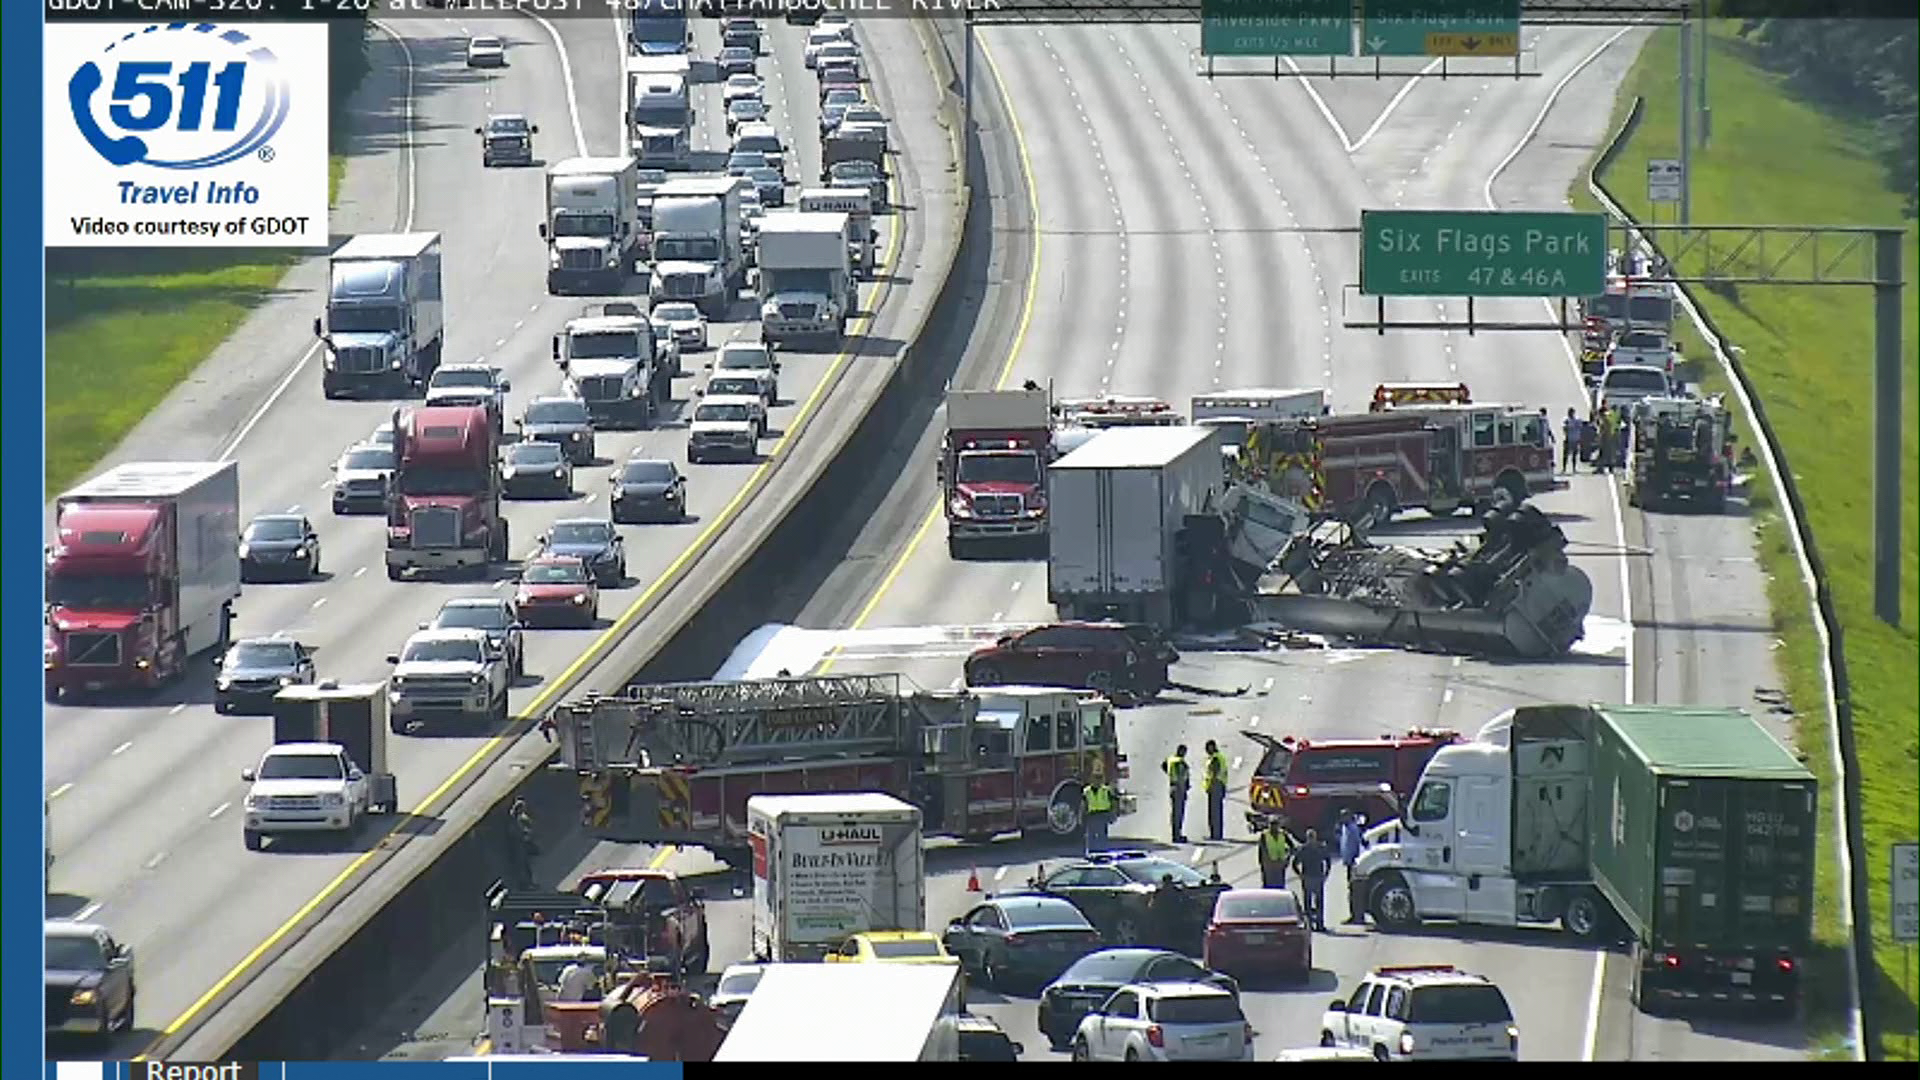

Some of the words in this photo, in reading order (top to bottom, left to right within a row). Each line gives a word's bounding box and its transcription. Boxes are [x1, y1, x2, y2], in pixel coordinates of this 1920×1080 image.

[1378, 229, 1421, 252] Six
[1437, 229, 1512, 260] Flags
[1526, 230, 1590, 254] Park
[1400, 269, 1440, 284] EXITS
